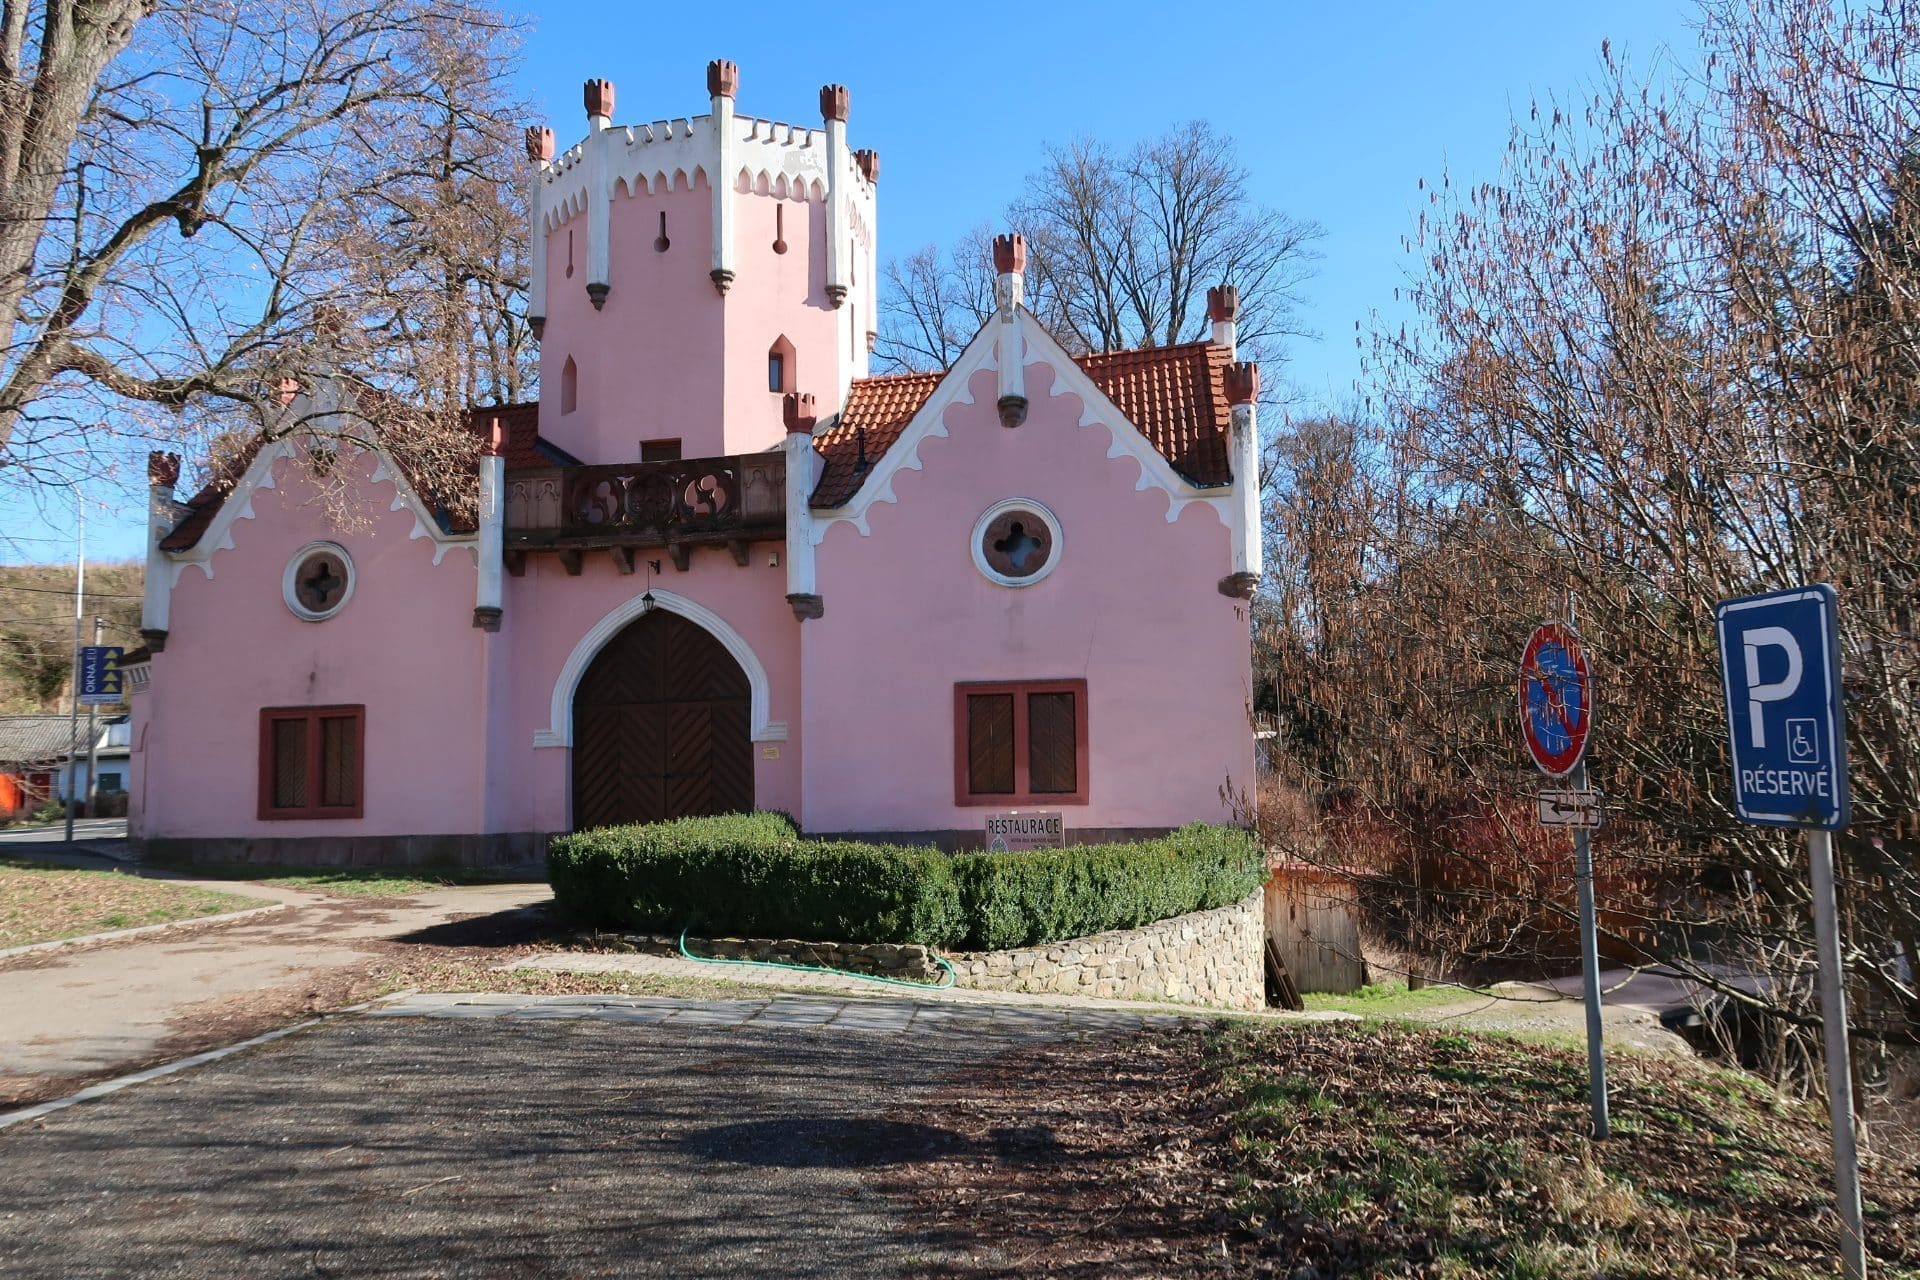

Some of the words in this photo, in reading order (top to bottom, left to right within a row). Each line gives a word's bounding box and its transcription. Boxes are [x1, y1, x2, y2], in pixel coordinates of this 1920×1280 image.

[85, 648, 96, 692] OKNA.EU
[1743, 626, 1803, 748] P
[1742, 764, 1829, 796] RÉSERVÉ
[988, 819, 1059, 834] RESTAURACE
